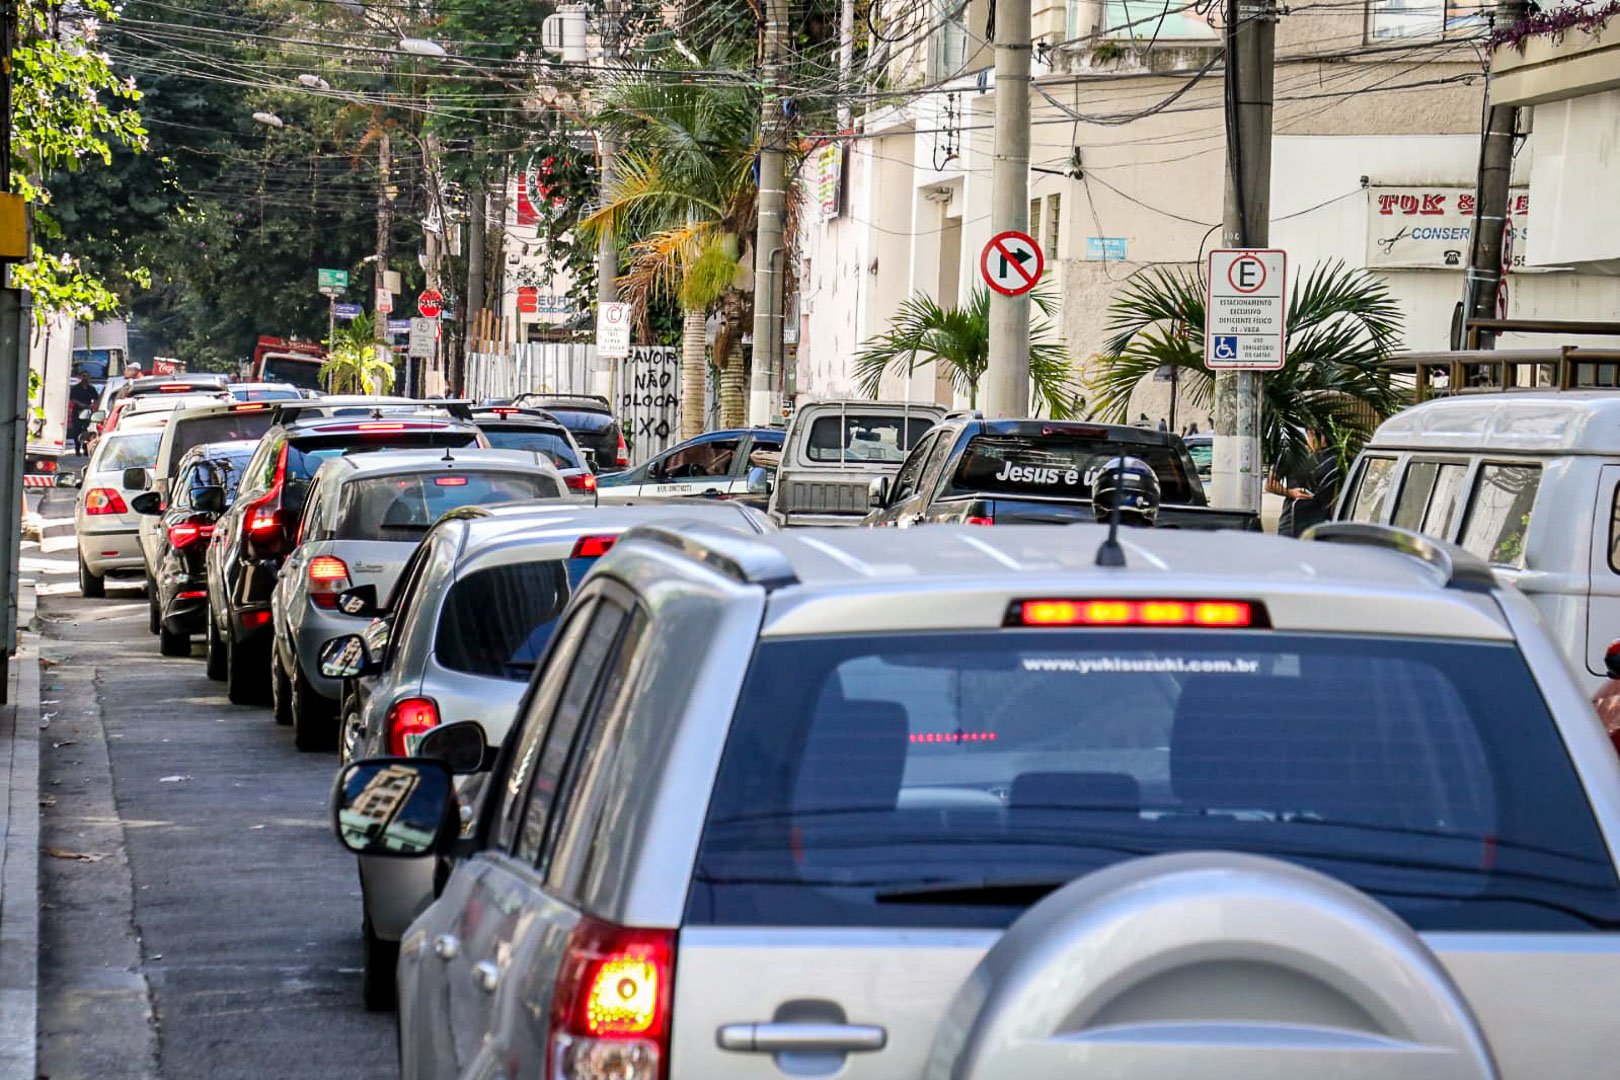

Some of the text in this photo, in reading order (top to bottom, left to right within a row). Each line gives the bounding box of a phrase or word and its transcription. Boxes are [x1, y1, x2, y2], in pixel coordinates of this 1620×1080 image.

[1378, 194, 1446, 215] TOK
[1239, 261, 1256, 287] E
[634, 369, 671, 390] NÃO
[995, 461, 1060, 484] Jesus
[1064, 464, 1079, 485] é
[1022, 657, 1259, 674] www.yukisuzuki.com.br
